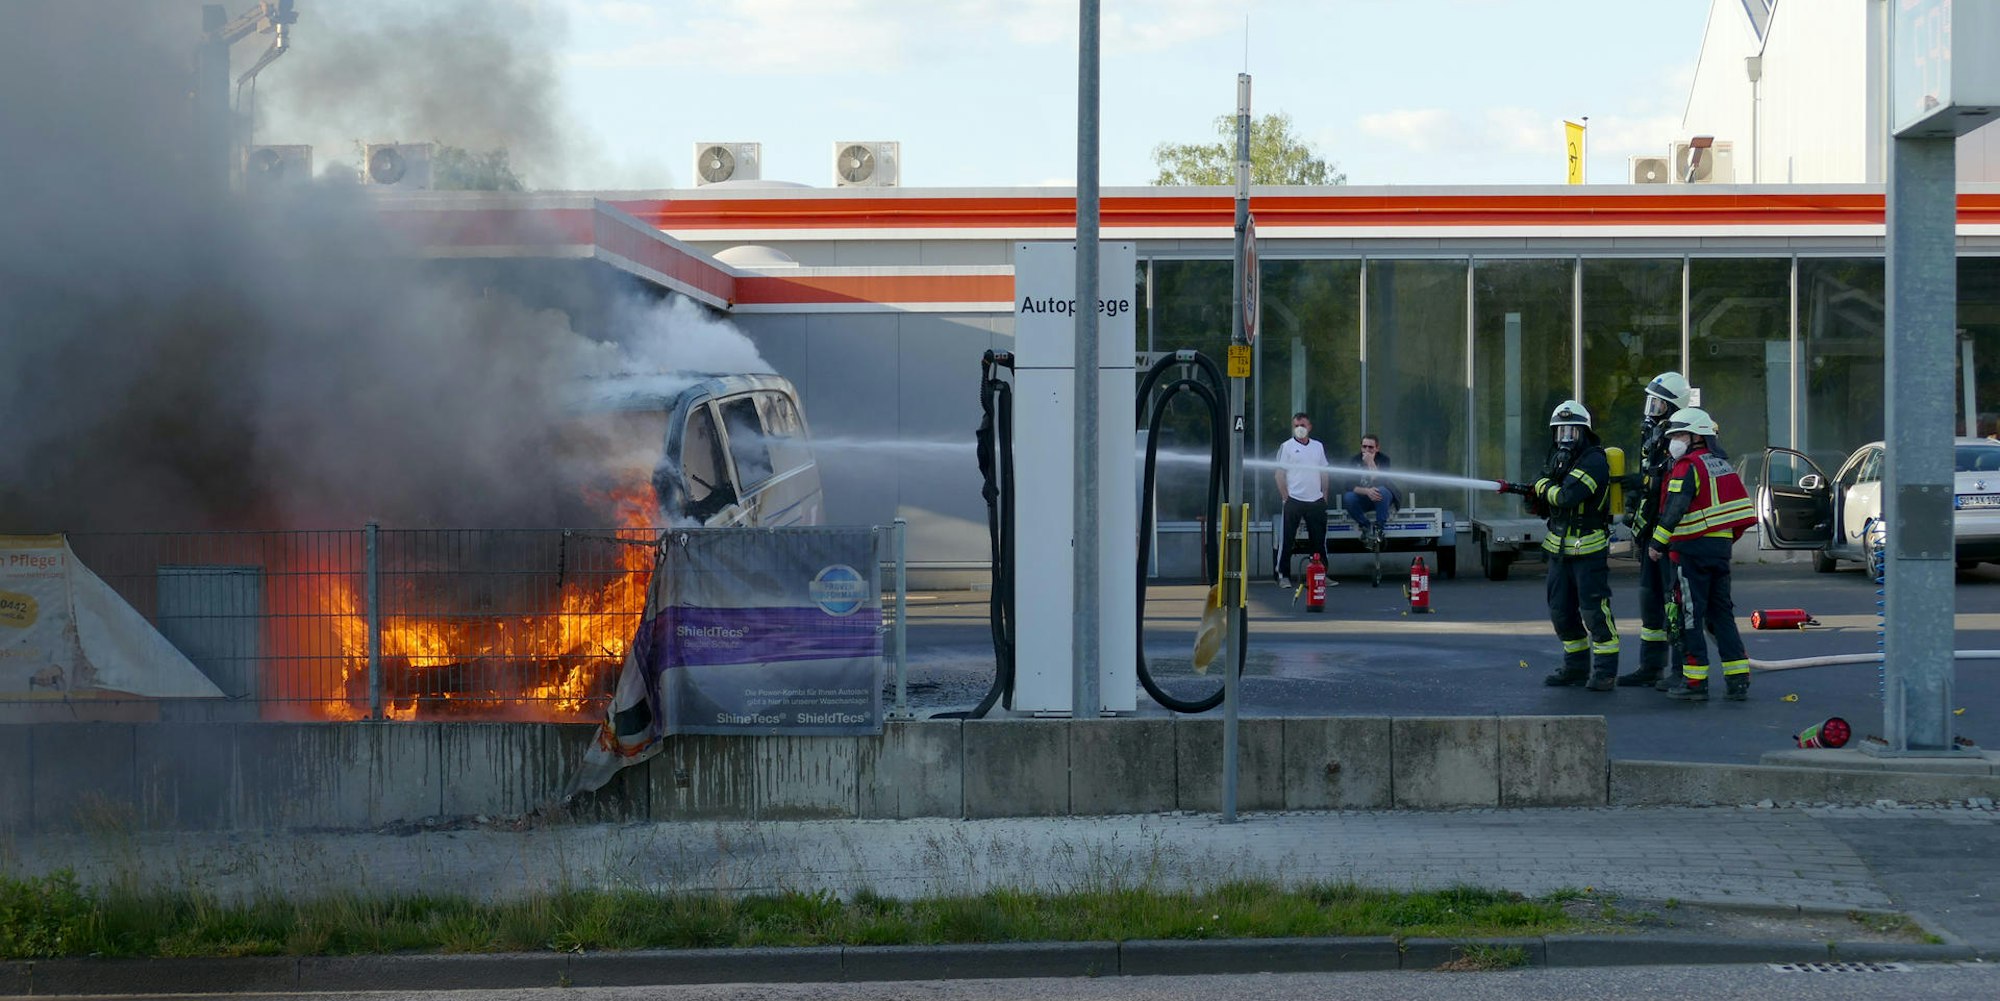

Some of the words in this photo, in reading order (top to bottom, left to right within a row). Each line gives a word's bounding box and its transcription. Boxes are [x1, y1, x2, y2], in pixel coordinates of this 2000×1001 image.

[1021, 296, 1129, 318] Autopege
[1234, 416, 1244, 430] A
[10, 554, 56, 569] Pflege
[676, 625, 750, 639] ShieldTecs®
[716, 712, 787, 725] ShineTecs®
[797, 711, 871, 724] ShieldTecs®
